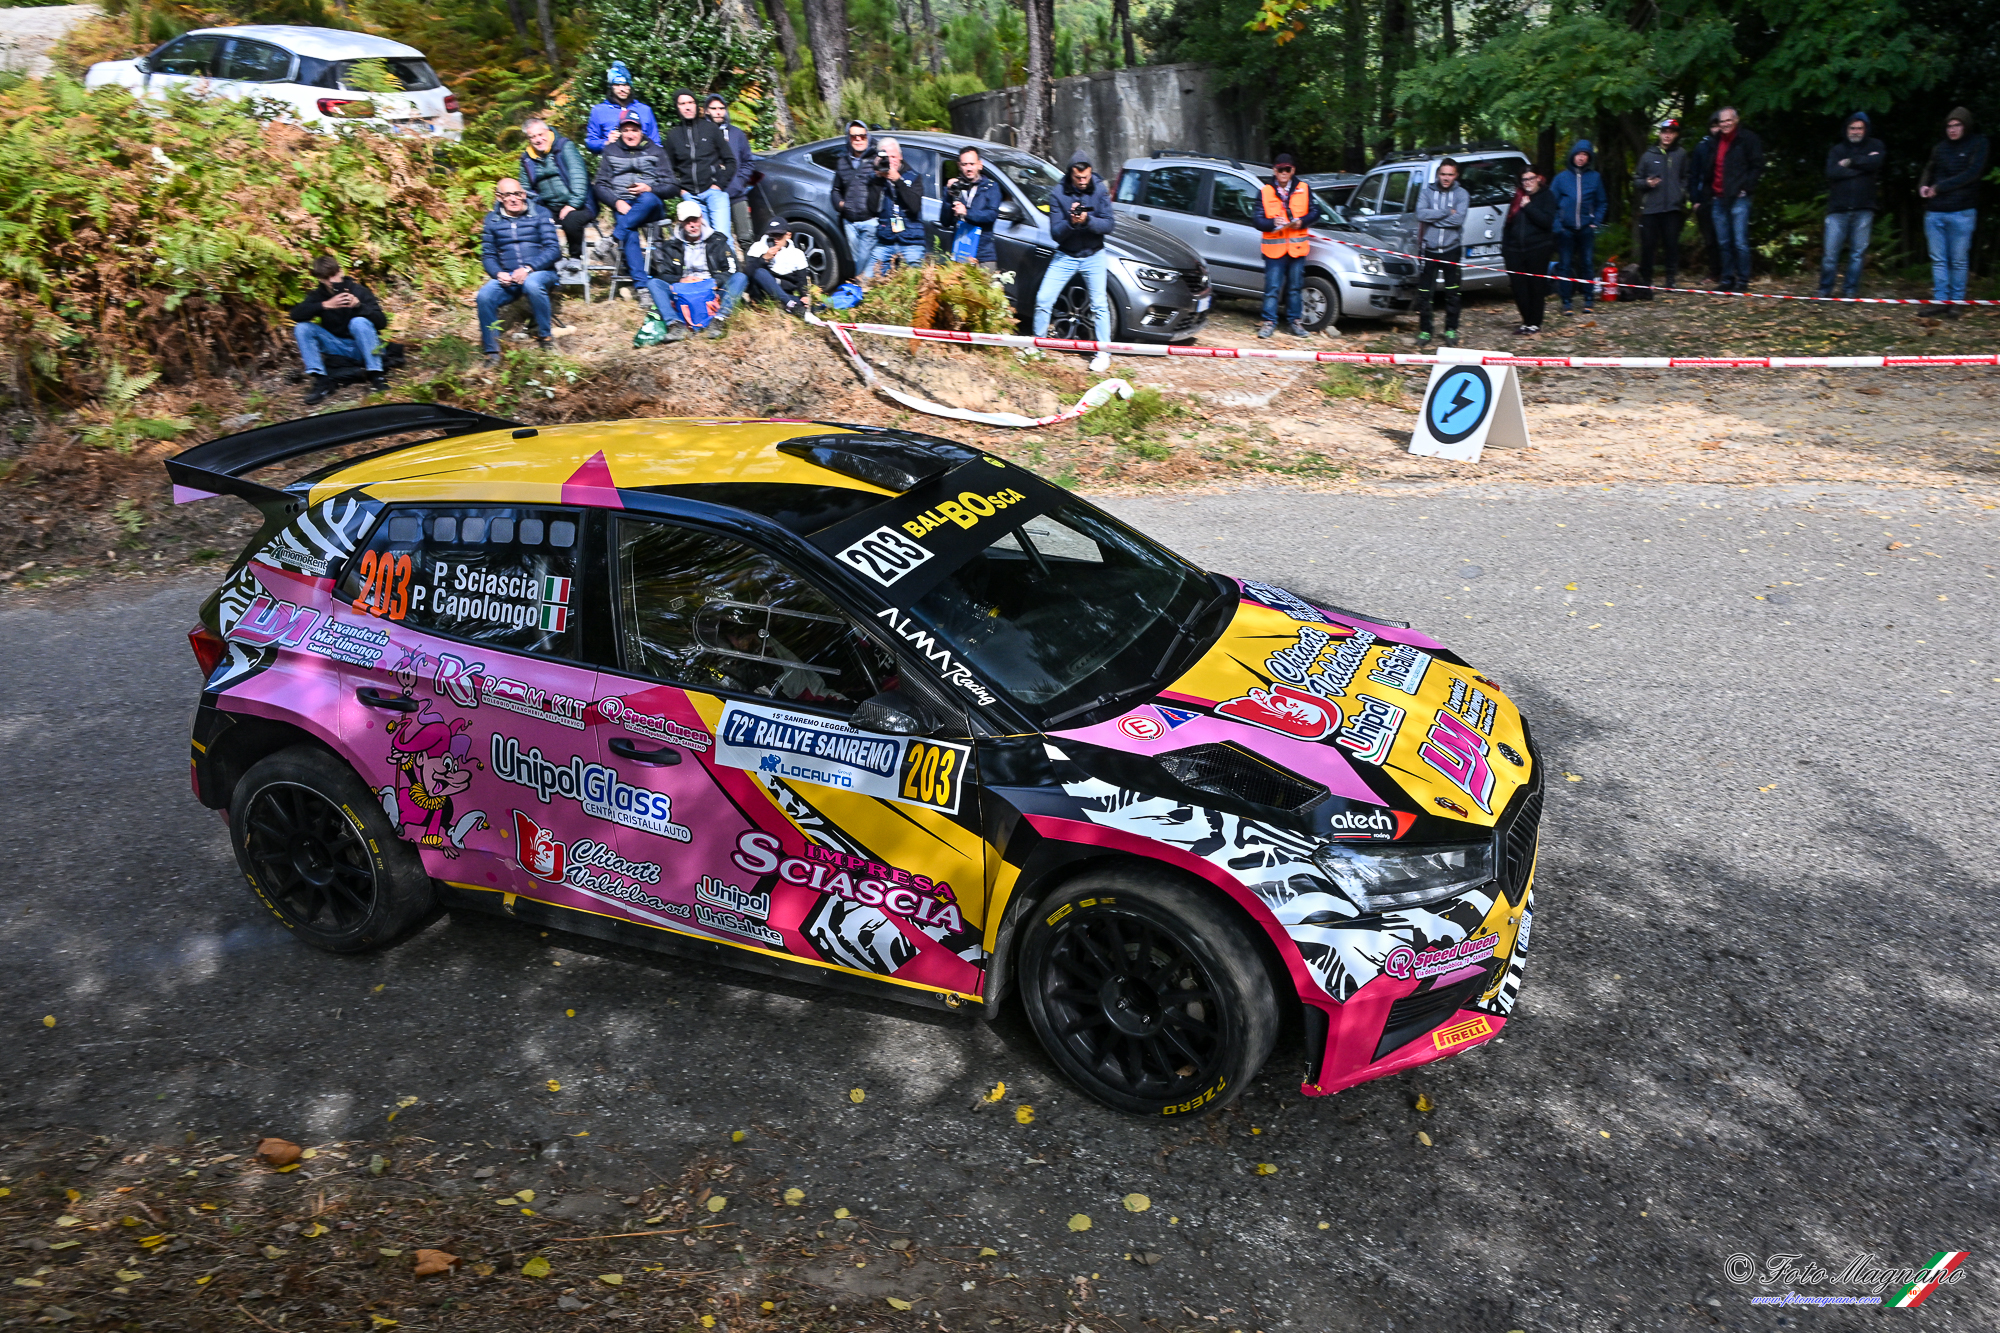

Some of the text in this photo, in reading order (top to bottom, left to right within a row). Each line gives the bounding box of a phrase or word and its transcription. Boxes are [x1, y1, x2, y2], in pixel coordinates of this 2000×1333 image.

[902, 487, 1026, 539] BALBOSCA
[847, 531, 925, 583] 203
[352, 549, 412, 620] 203
[433, 561, 539, 600] P. Sciascia
[411, 584, 538, 630] P. Capolongo
[311, 630, 382, 660] Martinengo
[325, 616, 389, 646] Lavanderia
[877, 607, 996, 706] ALMA Racing
[483, 696, 584, 729] NOLEGGIO BIANCHERIA SELF-SERVICE
[553, 695, 586, 718] KIT
[784, 714, 819, 727] SANREMO
[820, 721, 860, 736] LEGGENDA
[1340, 696, 1392, 751] Unipol
[622, 709, 708, 744] Speed Queen
[682, 739, 706, 751] SANREMO
[753, 720, 815, 753] RALLYE
[814, 734, 895, 773] SANREMO
[494, 736, 668, 820] UnipolGlass
[780, 763, 852, 788] LOCAUTO
[903, 743, 956, 806] 203
[585, 802, 688, 839] CENTRI CRISTALLI AUTO
[1330, 809, 1393, 831] atech
[571, 839, 661, 883] Chianti
[806, 843, 955, 900] IMPRESA
[566, 864, 691, 918] Valdelsa srl
[703, 876, 768, 912] Unipol
[734, 832, 963, 933] SCIASCIA
[696, 905, 782, 941] UniSalute
[1414, 933, 1497, 968] Speed Queen
[1416, 969, 1424, 977] Via
[1424, 967, 1437, 975] della
[1472, 949, 1493, 961] SANREMO
[1437, 1018, 1488, 1047] PIRELLI
